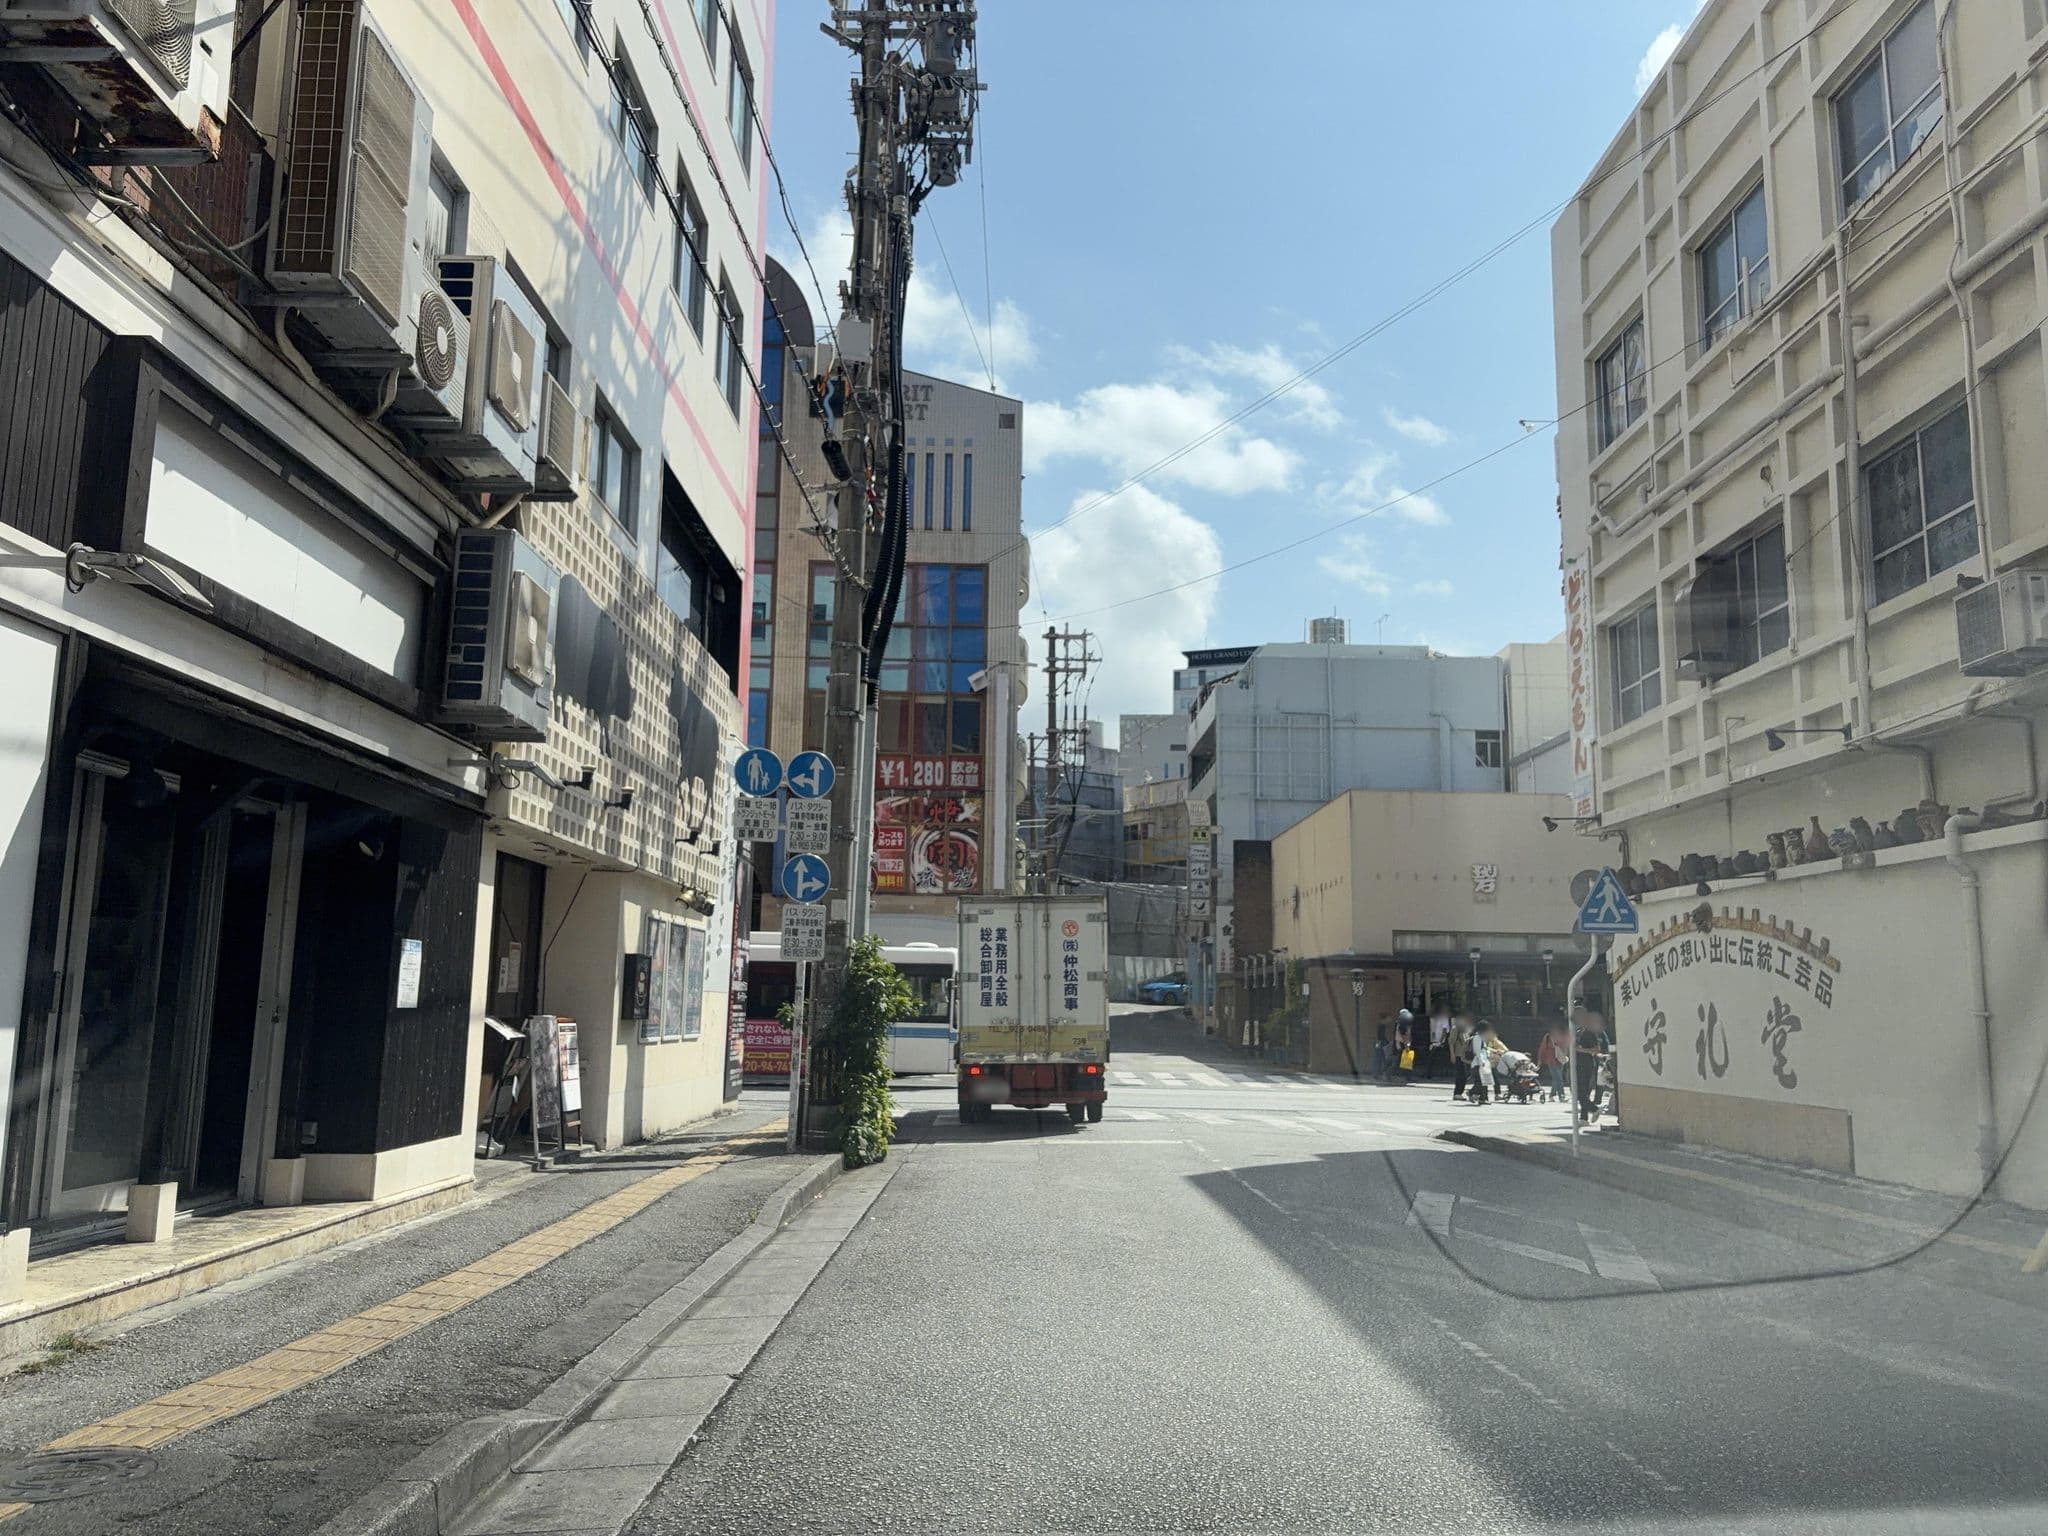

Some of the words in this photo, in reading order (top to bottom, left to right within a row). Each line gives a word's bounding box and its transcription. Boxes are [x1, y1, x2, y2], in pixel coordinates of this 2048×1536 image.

[1567, 568, 1588, 775] どらえもん
[880, 760, 944, 787] ¥1,280
[950, 760, 979, 774] 飲み
[879, 831, 904, 839] コースも
[879, 839, 904, 847] あります
[980, 927, 993, 1007] 総合卸問屋
[995, 927, 1008, 1007] 業務用全般
[1620, 935, 1833, 1009] 楽しい旅の想い出に伝統工芸品
[1642, 995, 1802, 1090] 守礼堂
